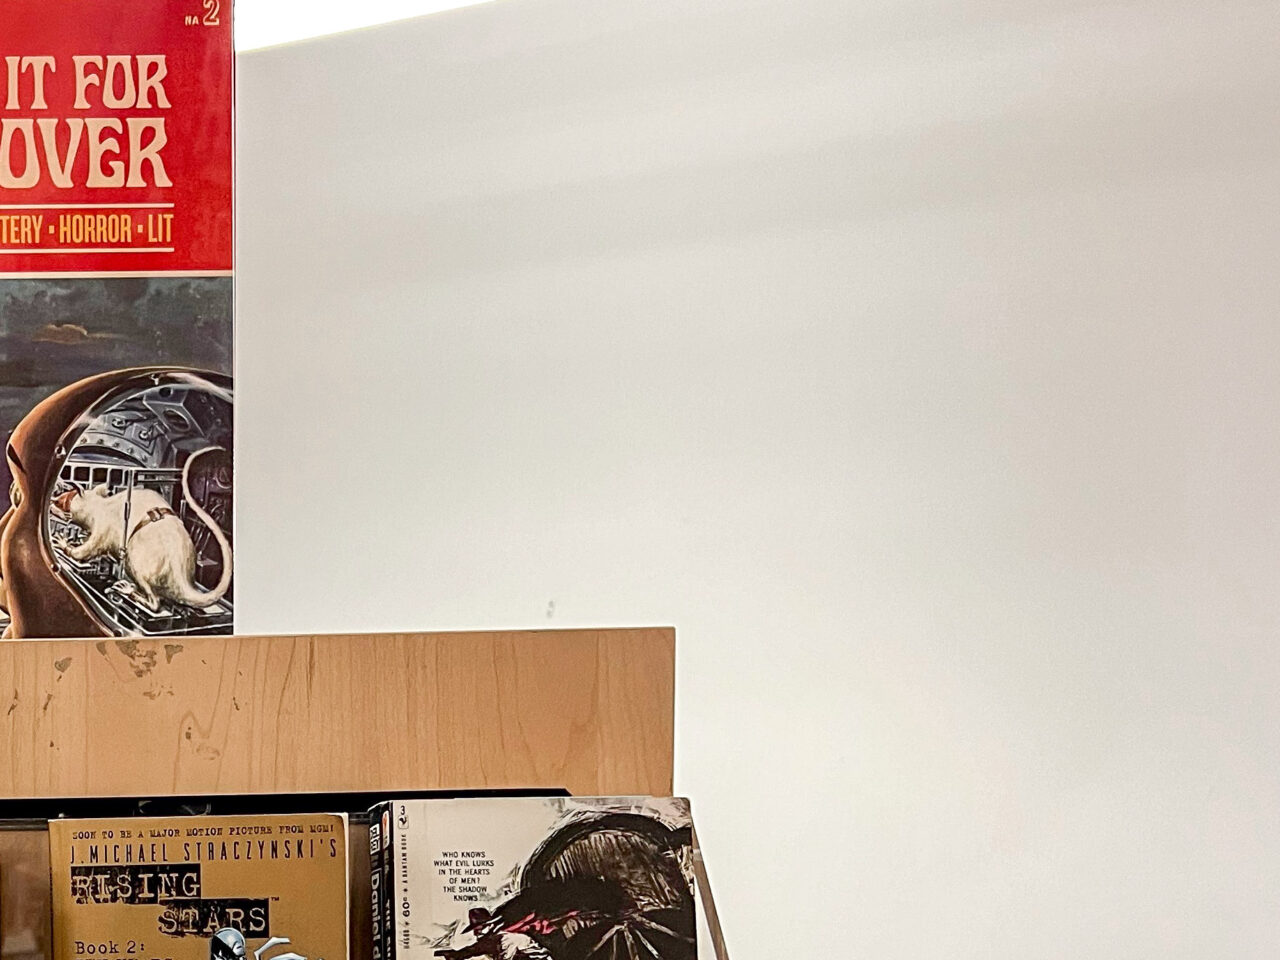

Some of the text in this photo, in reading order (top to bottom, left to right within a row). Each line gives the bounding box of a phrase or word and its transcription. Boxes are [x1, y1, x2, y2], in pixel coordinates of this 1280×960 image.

[184, 0, 220, 26] NA 2
[5, 55, 56, 110] IT
[72, 54, 172, 109] FOR
[59, 213, 132, 243] HORROR
[148, 212, 174, 243] LIT
[72, 823, 335, 840] SOON TO BE A MAJOR MOTION PICTURE FROM MGM!
[184, 838, 338, 862] STRACZYNSKI'S
[72, 872, 201, 899] RISING
[161, 906, 267, 933] STARS
[371, 873, 382, 940] Daniel
[75, 941, 145, 955] Book 2:
